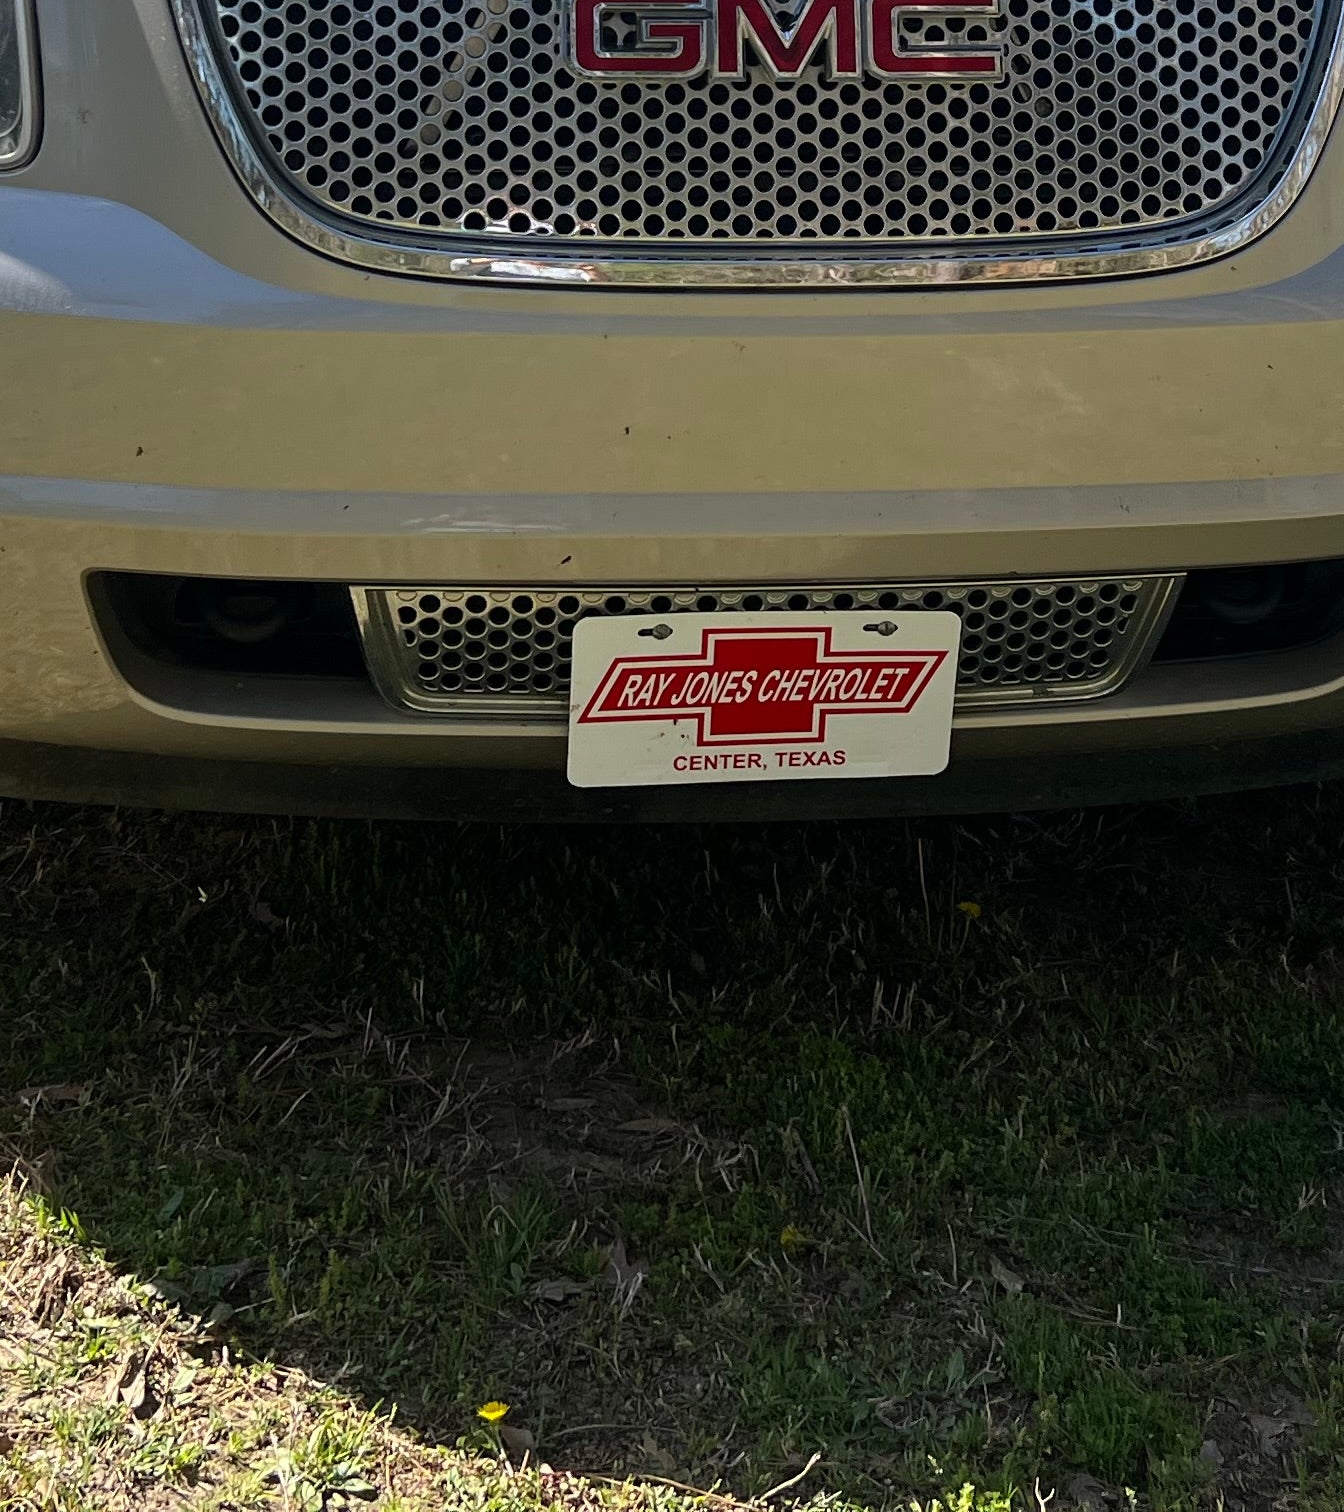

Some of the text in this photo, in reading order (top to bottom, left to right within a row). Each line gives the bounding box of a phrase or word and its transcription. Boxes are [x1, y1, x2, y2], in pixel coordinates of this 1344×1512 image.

[617, 667, 910, 707] RAY JONES CHEVROLET
[672, 749, 847, 772] CENTER, TEXAS
